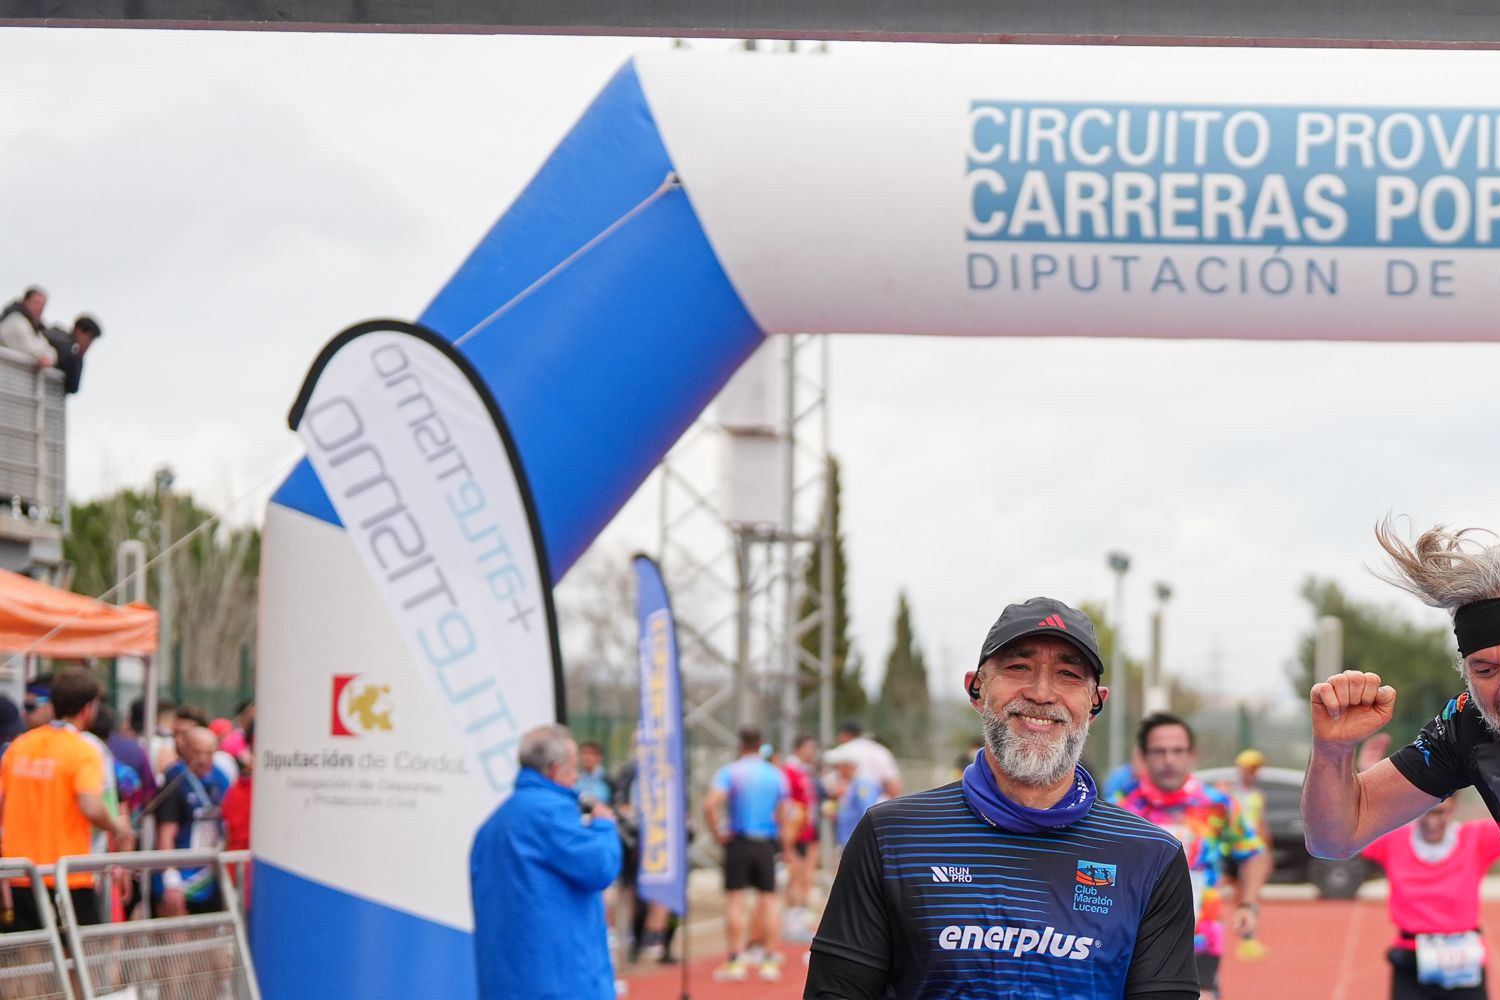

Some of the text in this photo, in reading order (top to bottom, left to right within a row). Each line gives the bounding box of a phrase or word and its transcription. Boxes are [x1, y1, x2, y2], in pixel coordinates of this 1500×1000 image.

[966, 106, 1271, 167] CIRCUITO
[966, 169, 1349, 242] CARRERAS
[967, 246, 1340, 297] DIPUTACIÓN
[1386, 258, 1458, 298] DE
[949, 867, 969, 875] RUN
[952, 875, 972, 883] PRO
[1074, 884, 1098, 896] Club
[1073, 893, 1113, 907] Maratón
[1072, 901, 1109, 915] Lucena
